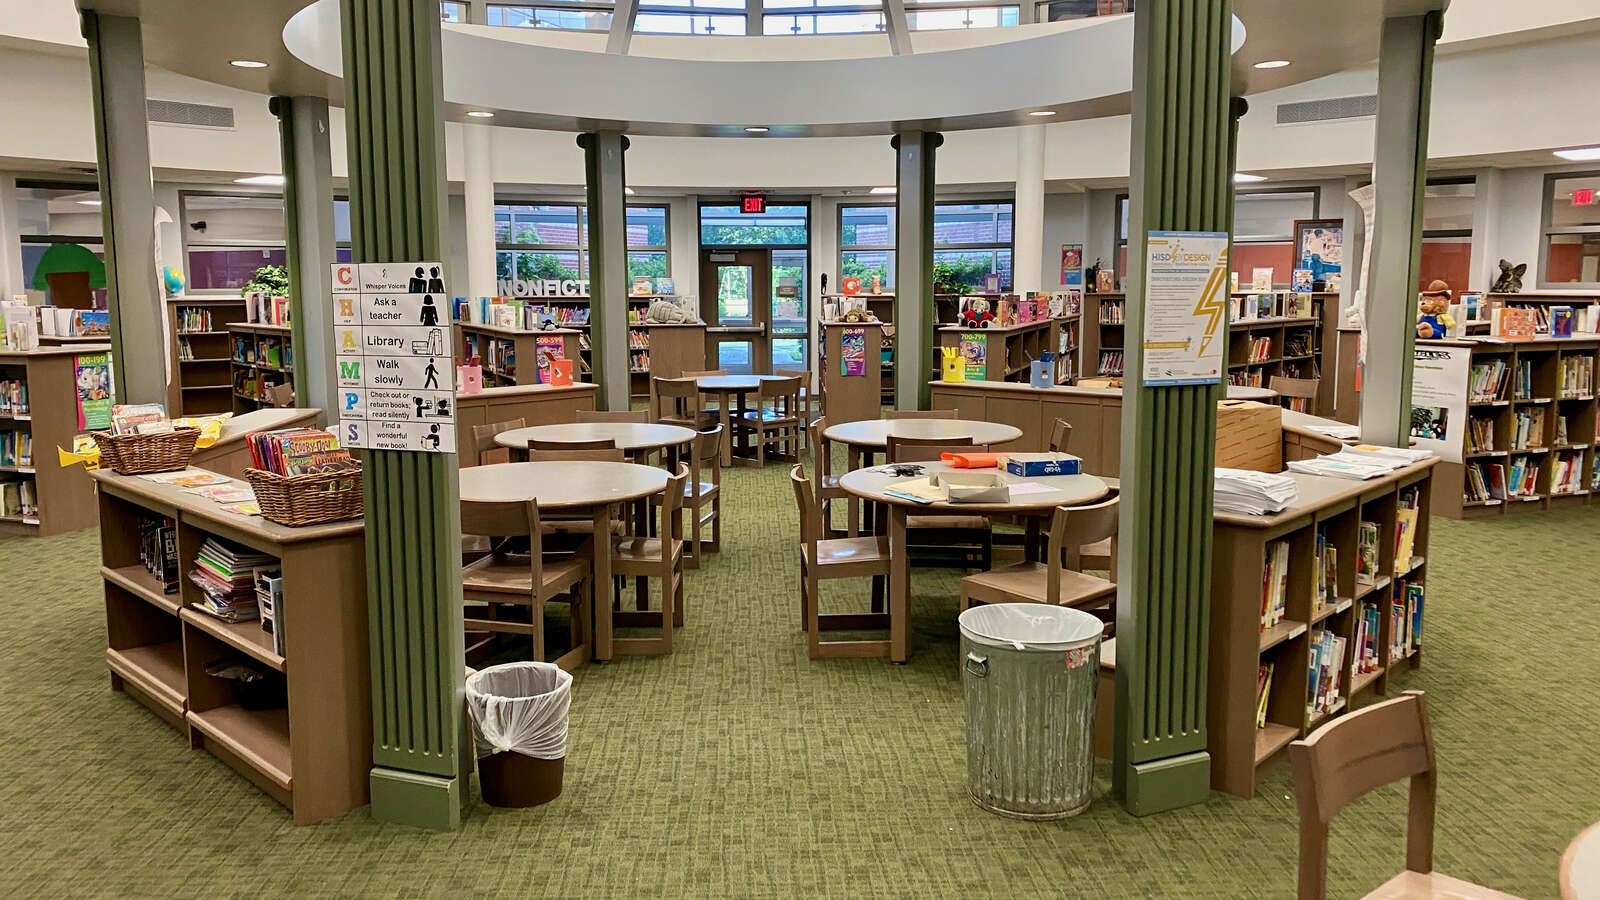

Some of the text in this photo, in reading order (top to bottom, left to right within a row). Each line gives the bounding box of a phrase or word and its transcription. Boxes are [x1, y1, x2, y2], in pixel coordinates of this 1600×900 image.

[744, 198, 763, 212] EXIT
[1152, 253, 1171, 261] HISD
[338, 267, 352, 285] C
[340, 299, 354, 316] H
[374, 298, 390, 306] Ask
[370, 312, 402, 320] teacher
[342, 330, 357, 348] A
[367, 336, 404, 348] Library
[78, 355, 106, 365] 100-199
[377, 360, 400, 369] Walk
[340, 362, 360, 379] M
[375, 376, 403, 386] slowly
[345, 393, 359, 410] P
[388, 412, 410, 420] silently
[348, 424, 358, 441] S
